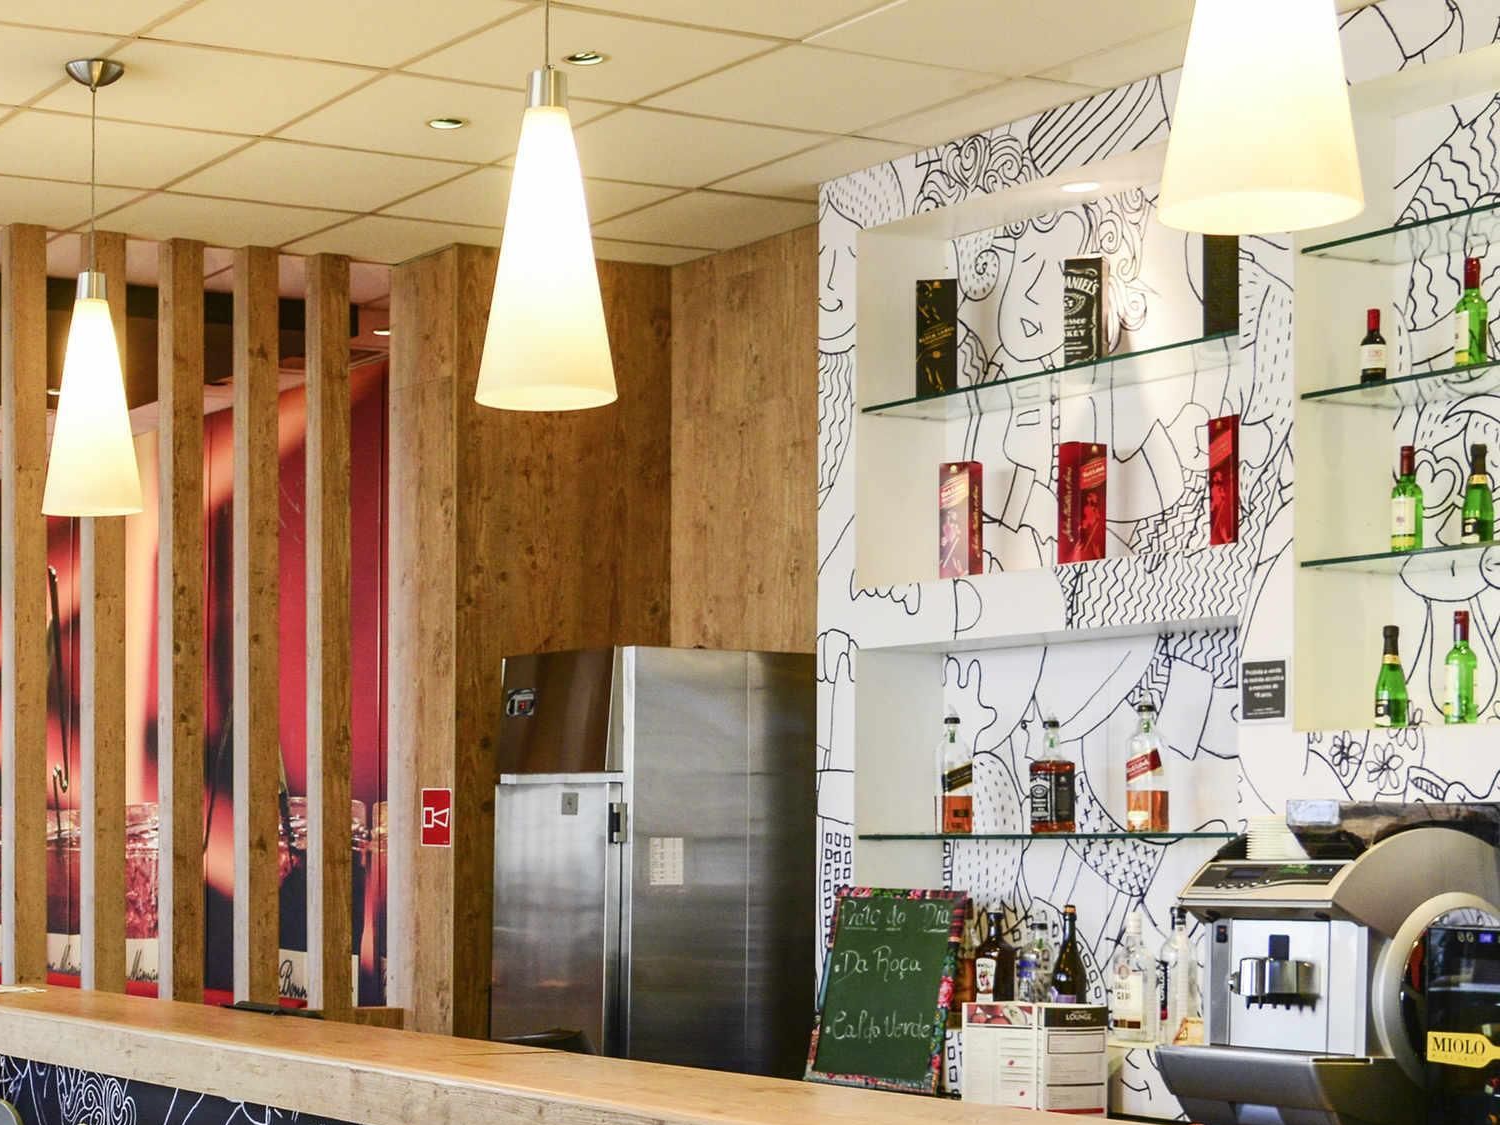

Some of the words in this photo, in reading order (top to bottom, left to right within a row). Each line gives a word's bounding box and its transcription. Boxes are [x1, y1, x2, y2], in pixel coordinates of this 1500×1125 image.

[1064, 275, 1099, 295] ANIEL'S
[919, 903, 950, 925] Dia
[837, 950, 869, 979] Da
[1432, 1037, 1485, 1056] MIOLO
